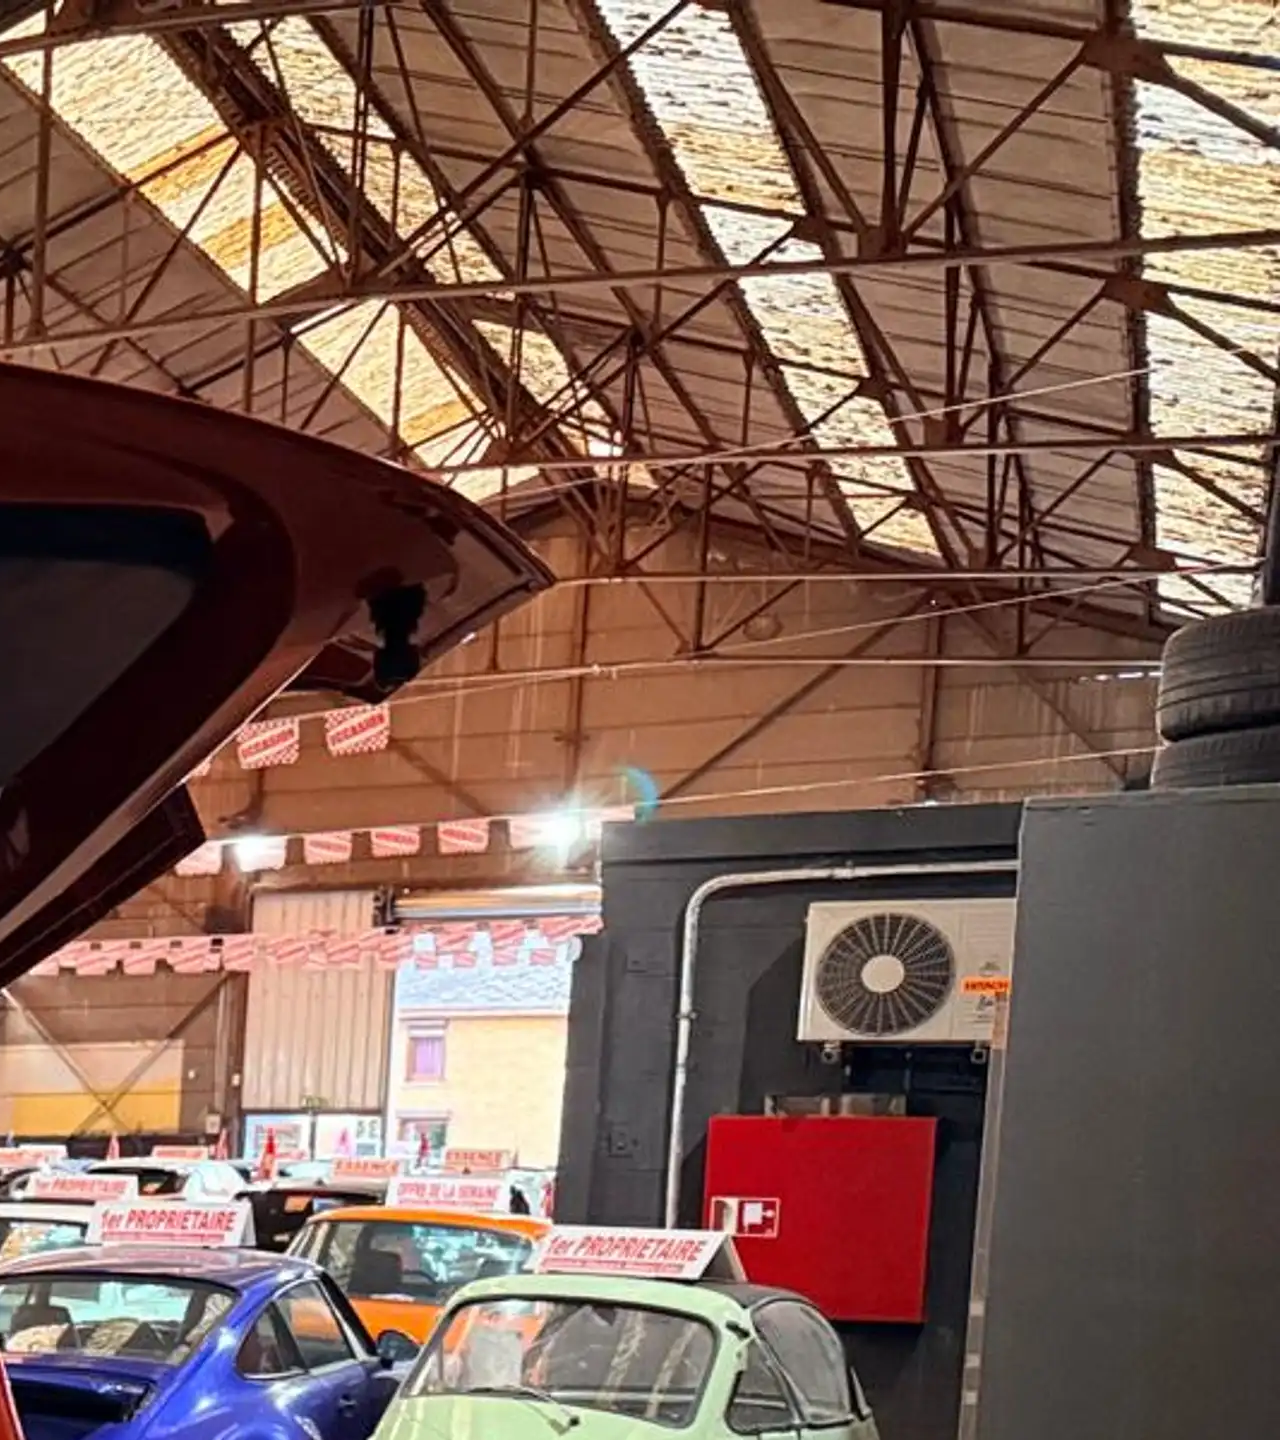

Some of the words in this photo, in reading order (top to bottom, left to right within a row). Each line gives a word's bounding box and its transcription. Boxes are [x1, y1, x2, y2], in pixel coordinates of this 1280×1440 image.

[101, 1209, 123, 1229] 1er
[125, 1209, 237, 1232] PROPRIETAIRE
[547, 1235, 574, 1255] 1er
[574, 1234, 707, 1262] PROPRIETAIRE
